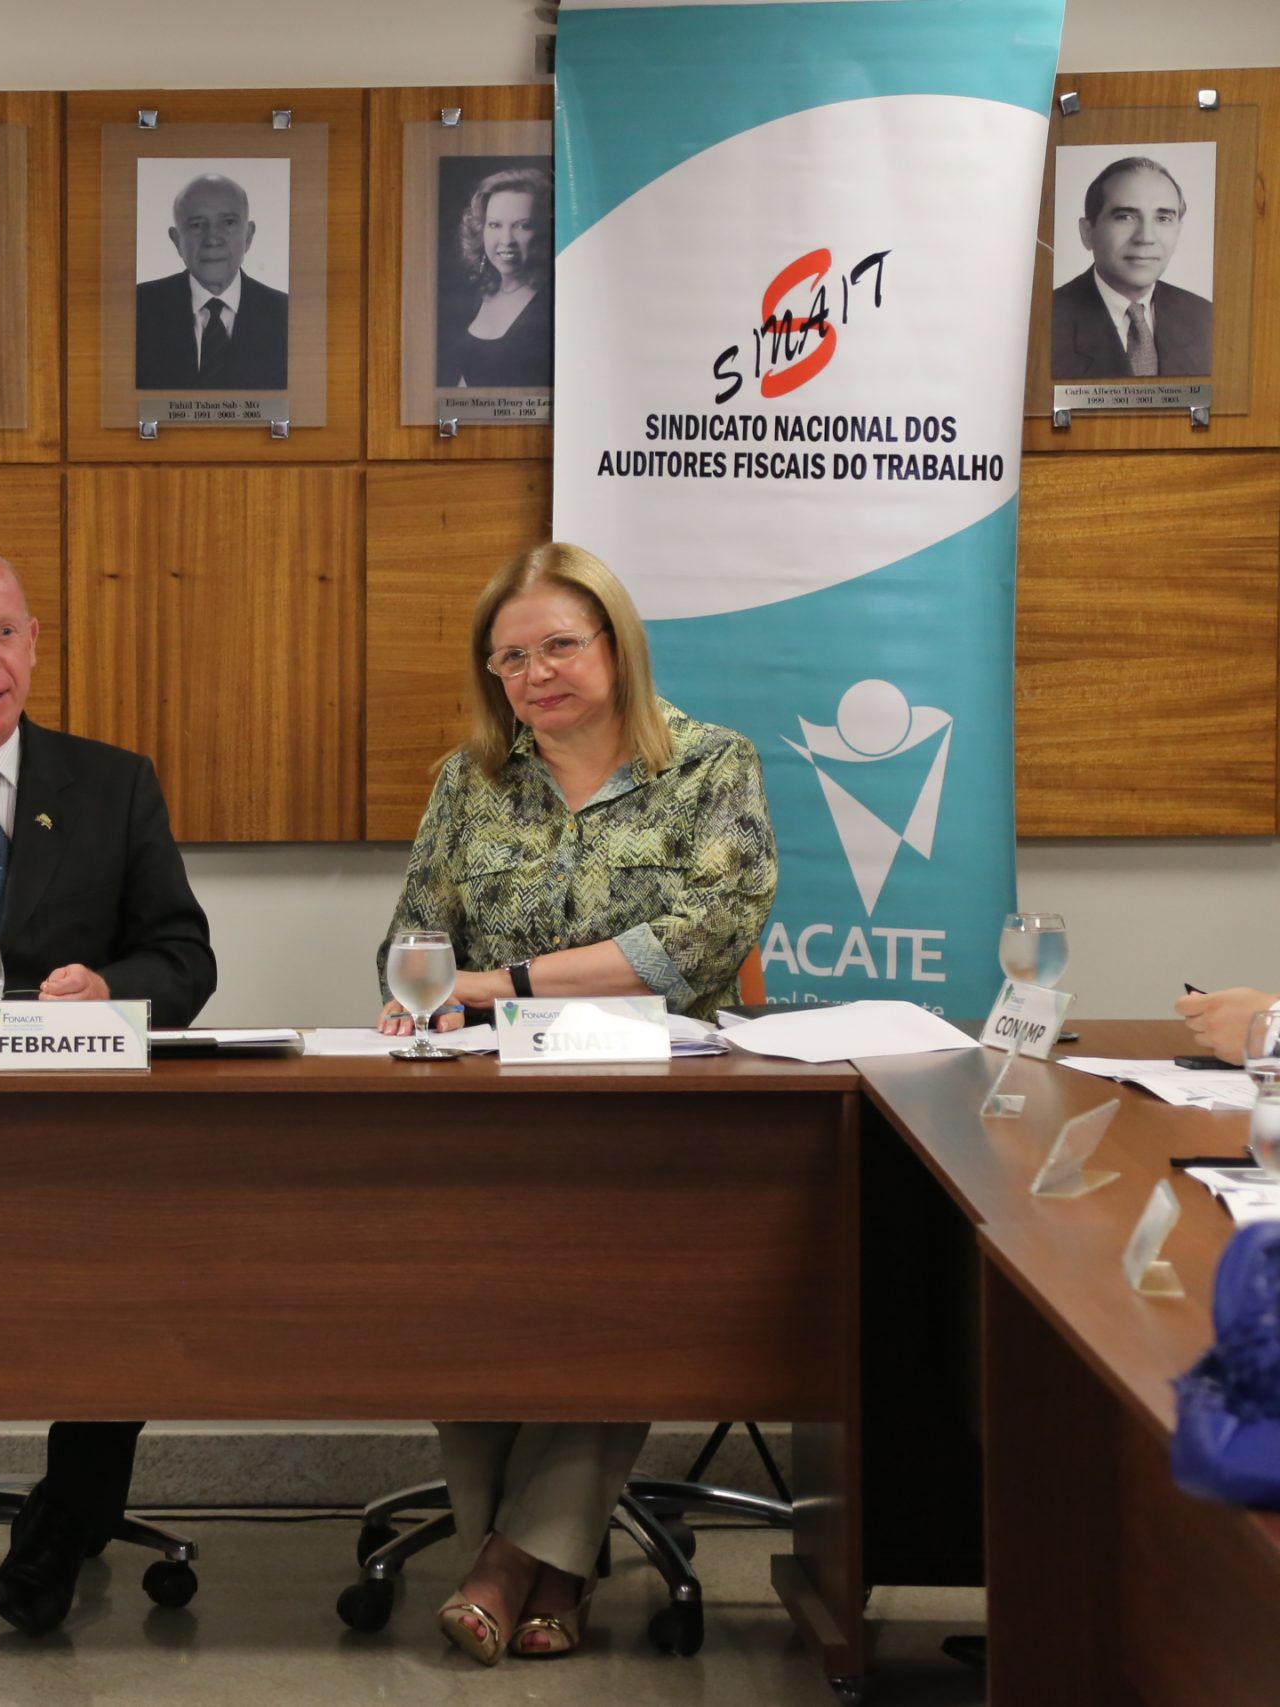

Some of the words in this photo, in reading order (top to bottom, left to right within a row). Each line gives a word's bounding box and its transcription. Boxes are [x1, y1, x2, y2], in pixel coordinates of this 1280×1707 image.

[1064, 387, 1090, 395] Carlos
[1093, 387, 1121, 395] Alberto
[169, 401, 193, 410] Fahid
[196, 401, 221, 410] Tahan
[245, 401, 260, 410] MG
[471, 399, 495, 408] Maria
[525, 399, 535, 407] de
[644, 413, 767, 442] SINDICATO
[773, 415, 898, 443] NACIONAL
[904, 416, 958, 443] DOS
[597, 450, 727, 478] AUDITORES
[732, 452, 826, 480] FISCAIS
[832, 453, 868, 481] DO
[873, 453, 1004, 482] TRABALHO
[761, 922, 946, 983] ACATE
[2, 1013, 43, 1024] FONACATE
[532, 1031, 632, 1052] SINAIT
